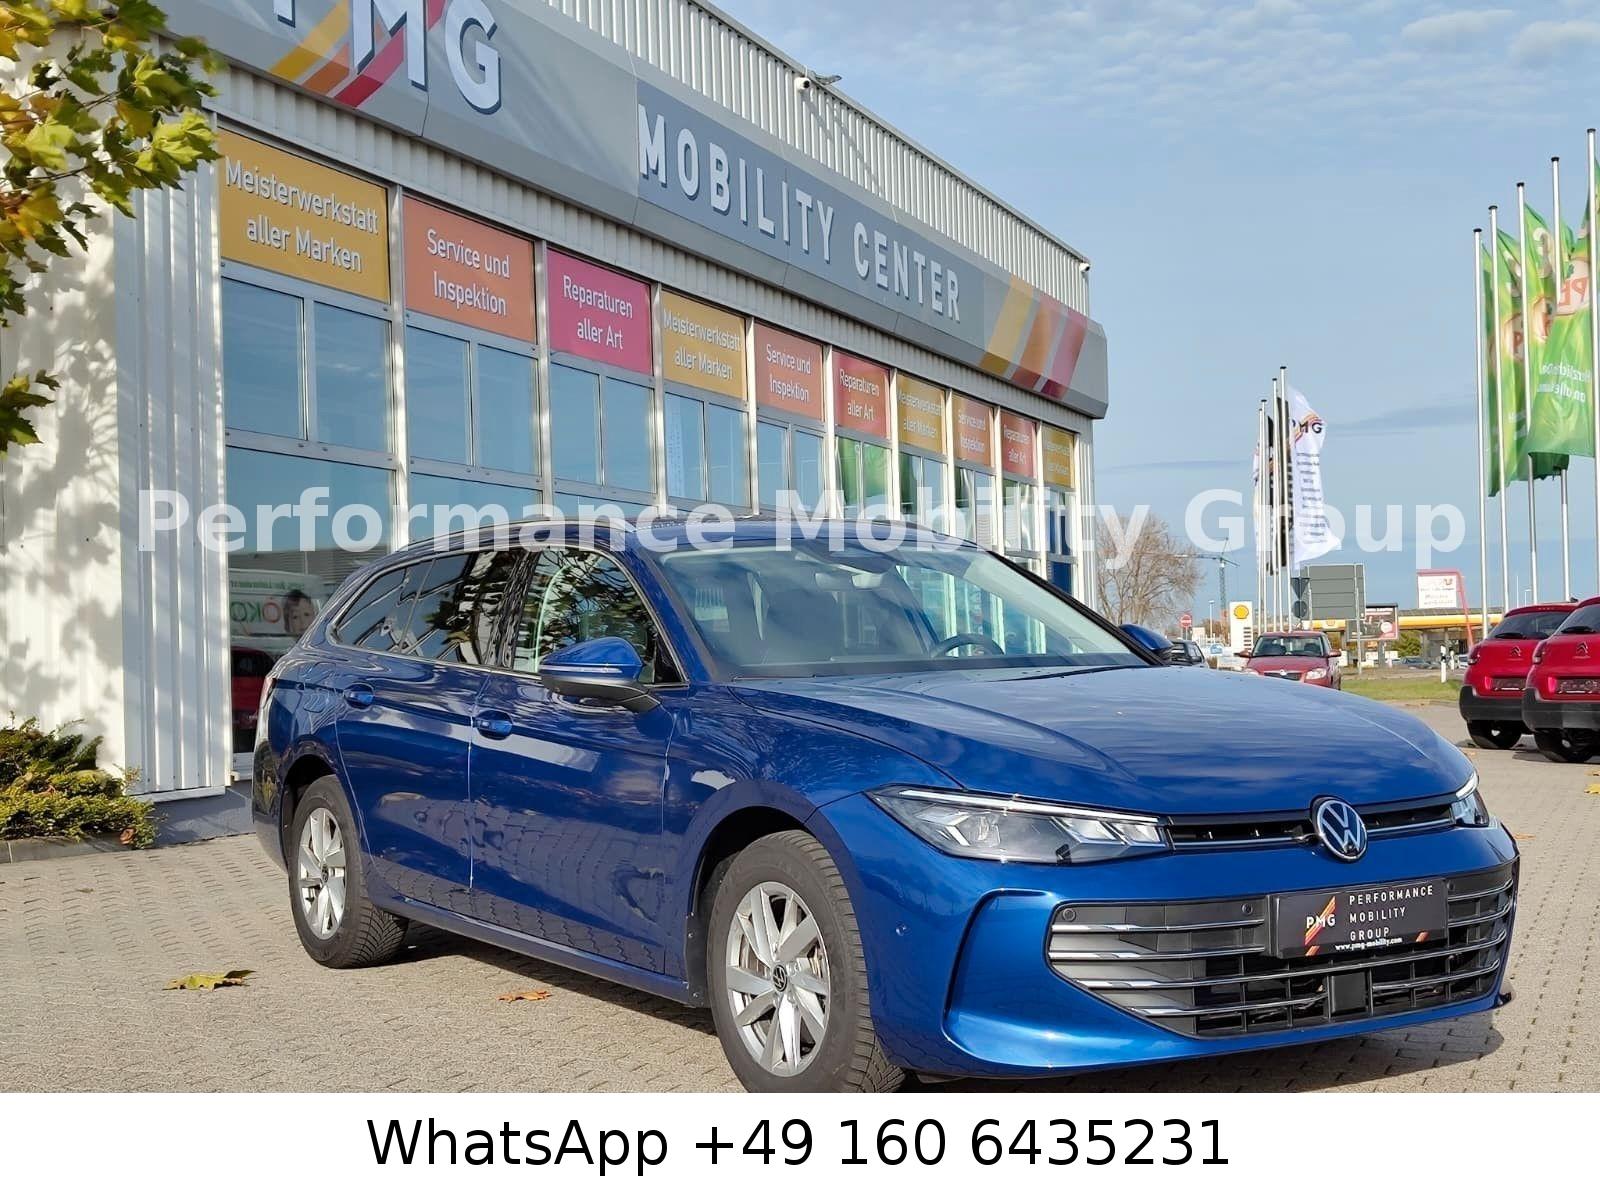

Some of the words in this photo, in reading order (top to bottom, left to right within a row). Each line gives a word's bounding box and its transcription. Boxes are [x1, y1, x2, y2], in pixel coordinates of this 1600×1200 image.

[274, 0, 502, 114] MG
[225, 155, 379, 235] Meisterwerkstatt
[637, 103, 835, 265] MOBILITY
[853, 221, 961, 324] CENTER
[246, 214, 291, 251] aller
[295, 225, 362, 273] Marken
[427, 228, 480, 270] Service
[484, 253, 510, 279] und
[433, 270, 506, 317] Inspektion
[563, 274, 633, 319] Reparaturen
[577, 317, 603, 344] aller
[606, 325, 624, 350] Art
[663, 309, 741, 352] Meisterwerkstatt
[674, 346, 697, 370] aller
[699, 352, 732, 379] Marken
[766, 343, 795, 371] Service
[796, 356, 811, 375] und
[769, 373, 809, 403] Inspektion
[839, 368, 880, 397] Reparaturen
[1349, 885, 1433, 905] PERFORMANCE
[1306, 914, 1336, 929] PMG
[1349, 906, 1406, 924] MOBILITY
[1335, 936, 1403, 951] www.pmg-mobility.com
[1350, 927, 1391, 942] GROUP
